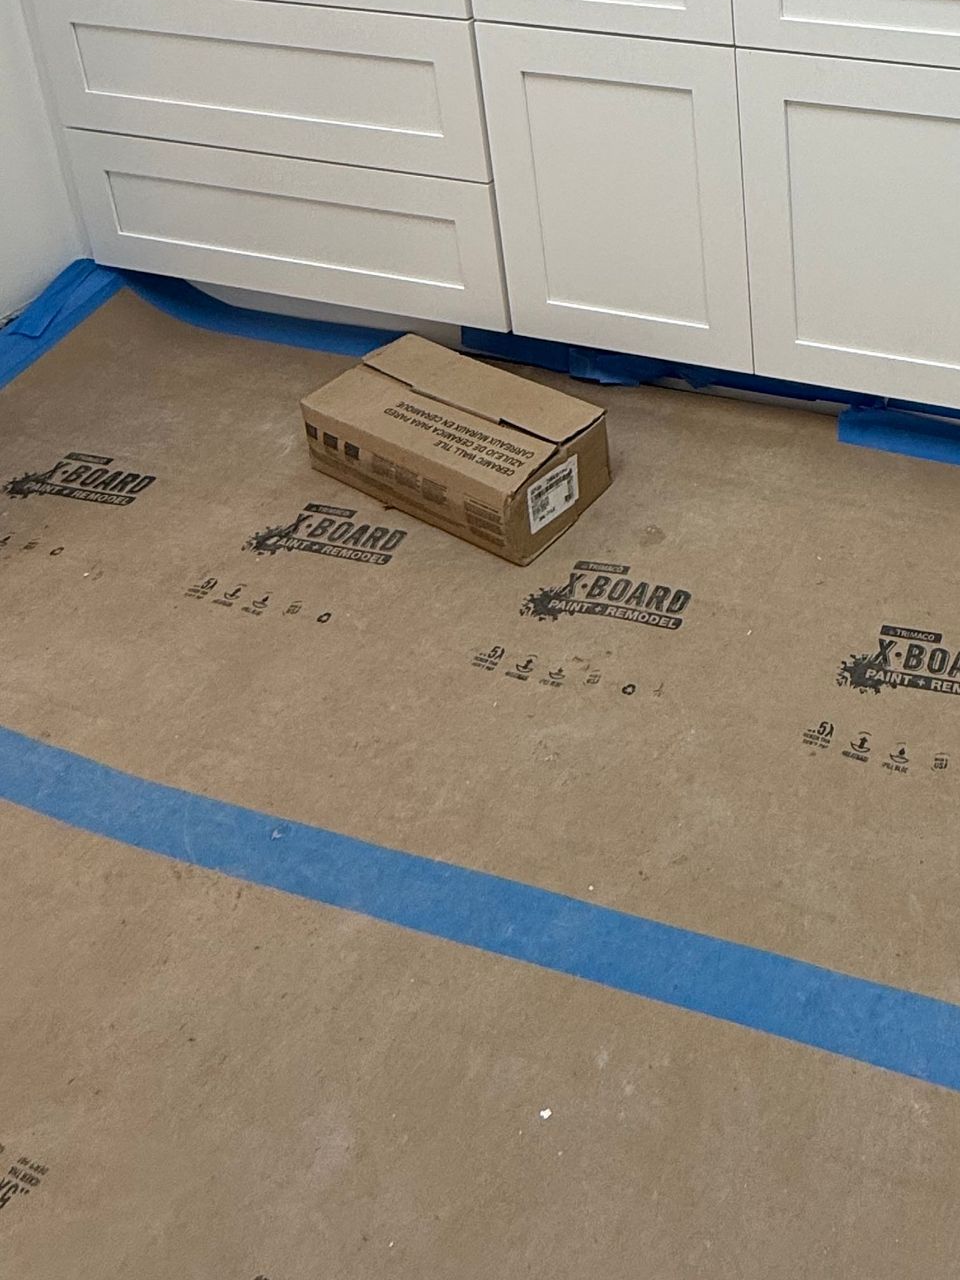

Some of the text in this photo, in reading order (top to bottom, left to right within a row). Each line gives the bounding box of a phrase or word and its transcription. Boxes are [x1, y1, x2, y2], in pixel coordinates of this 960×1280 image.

[441, 418, 455, 428] EN
[453, 424, 491, 445] MURAUX
[433, 439, 515, 477] CERAMIC WALL TILE
[472, 443, 487, 454] DE
[486, 445, 526, 468] AZULEJO
[491, 437, 535, 460] CARREAUX
[321, 544, 386, 564] REMODEL
[548, 598, 593, 614] PAINT
[606, 606, 678, 629] REMODEL
[895, 627, 936, 642] TRIMACO
[865, 668, 912, 686] PAINT
